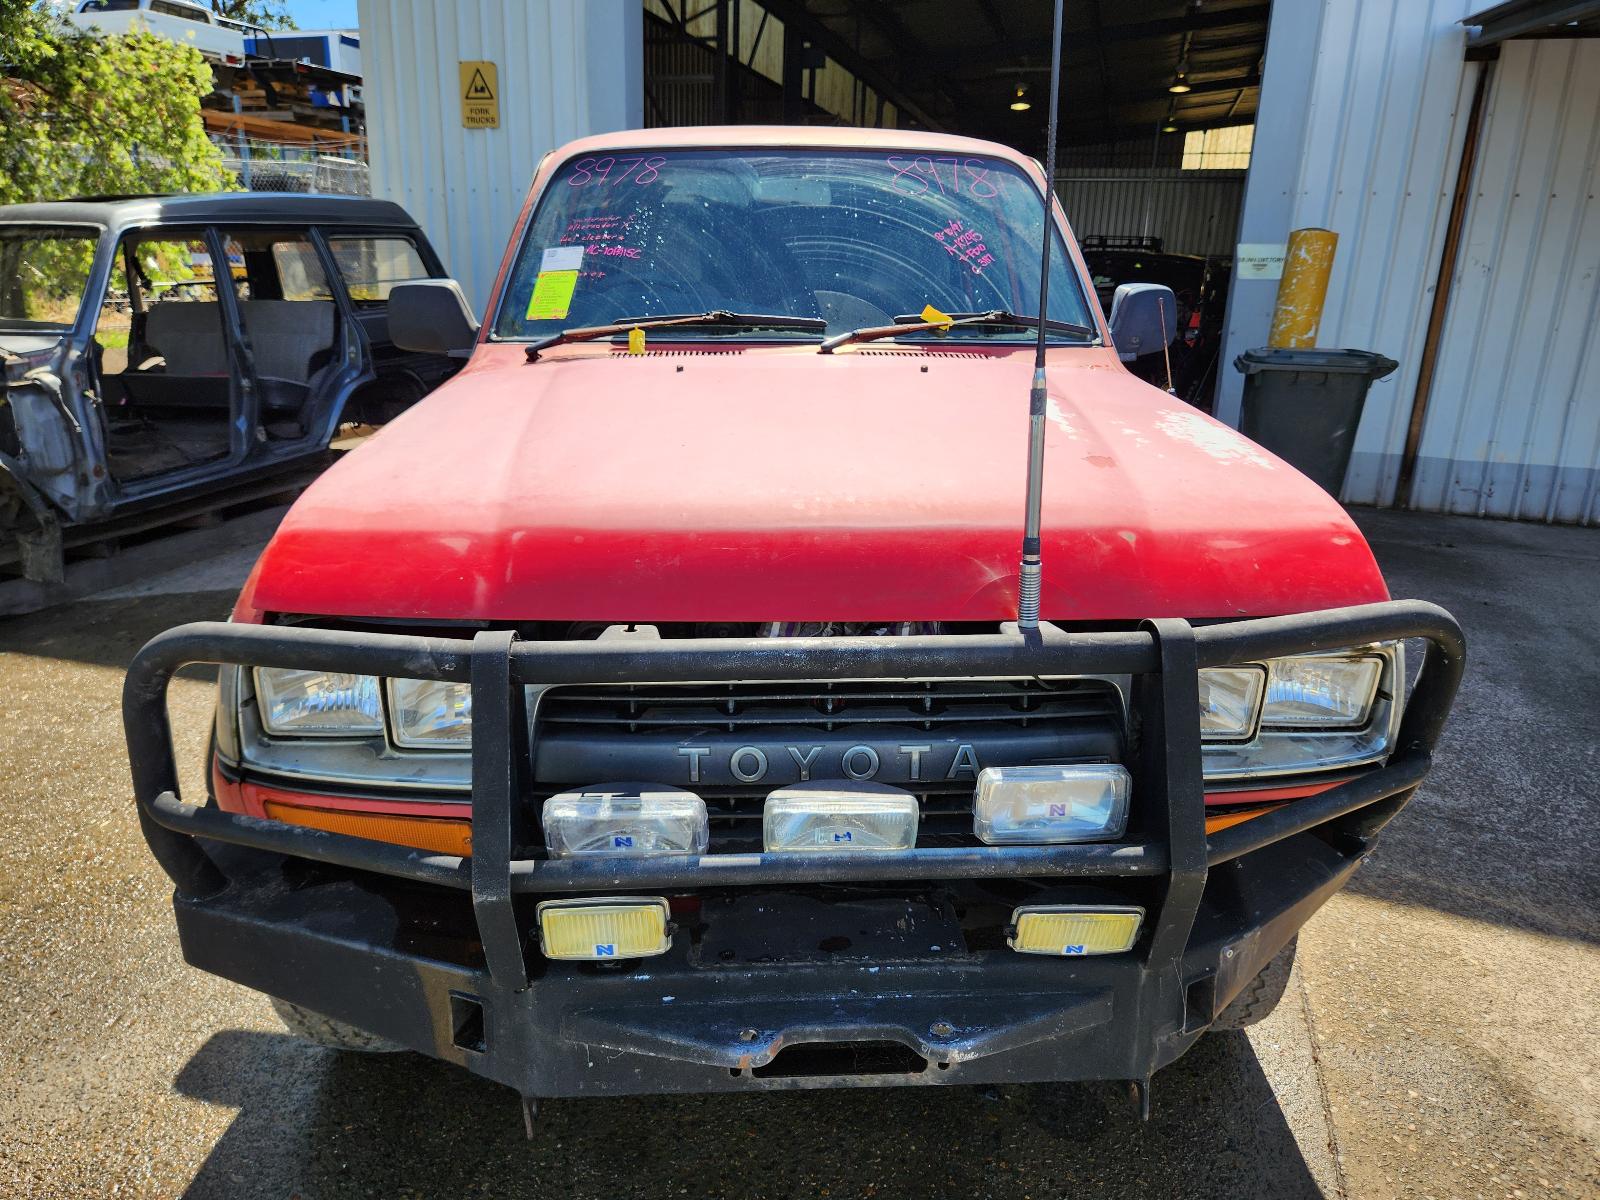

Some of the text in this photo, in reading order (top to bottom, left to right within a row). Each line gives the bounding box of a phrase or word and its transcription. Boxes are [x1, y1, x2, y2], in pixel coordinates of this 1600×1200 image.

[466, 116, 496, 124] TRUCKS
[470, 107, 490, 115] FORK
[568, 156, 667, 187] 8978
[887, 155, 998, 198] 8978
[677, 743, 982, 783] TOYOTA
